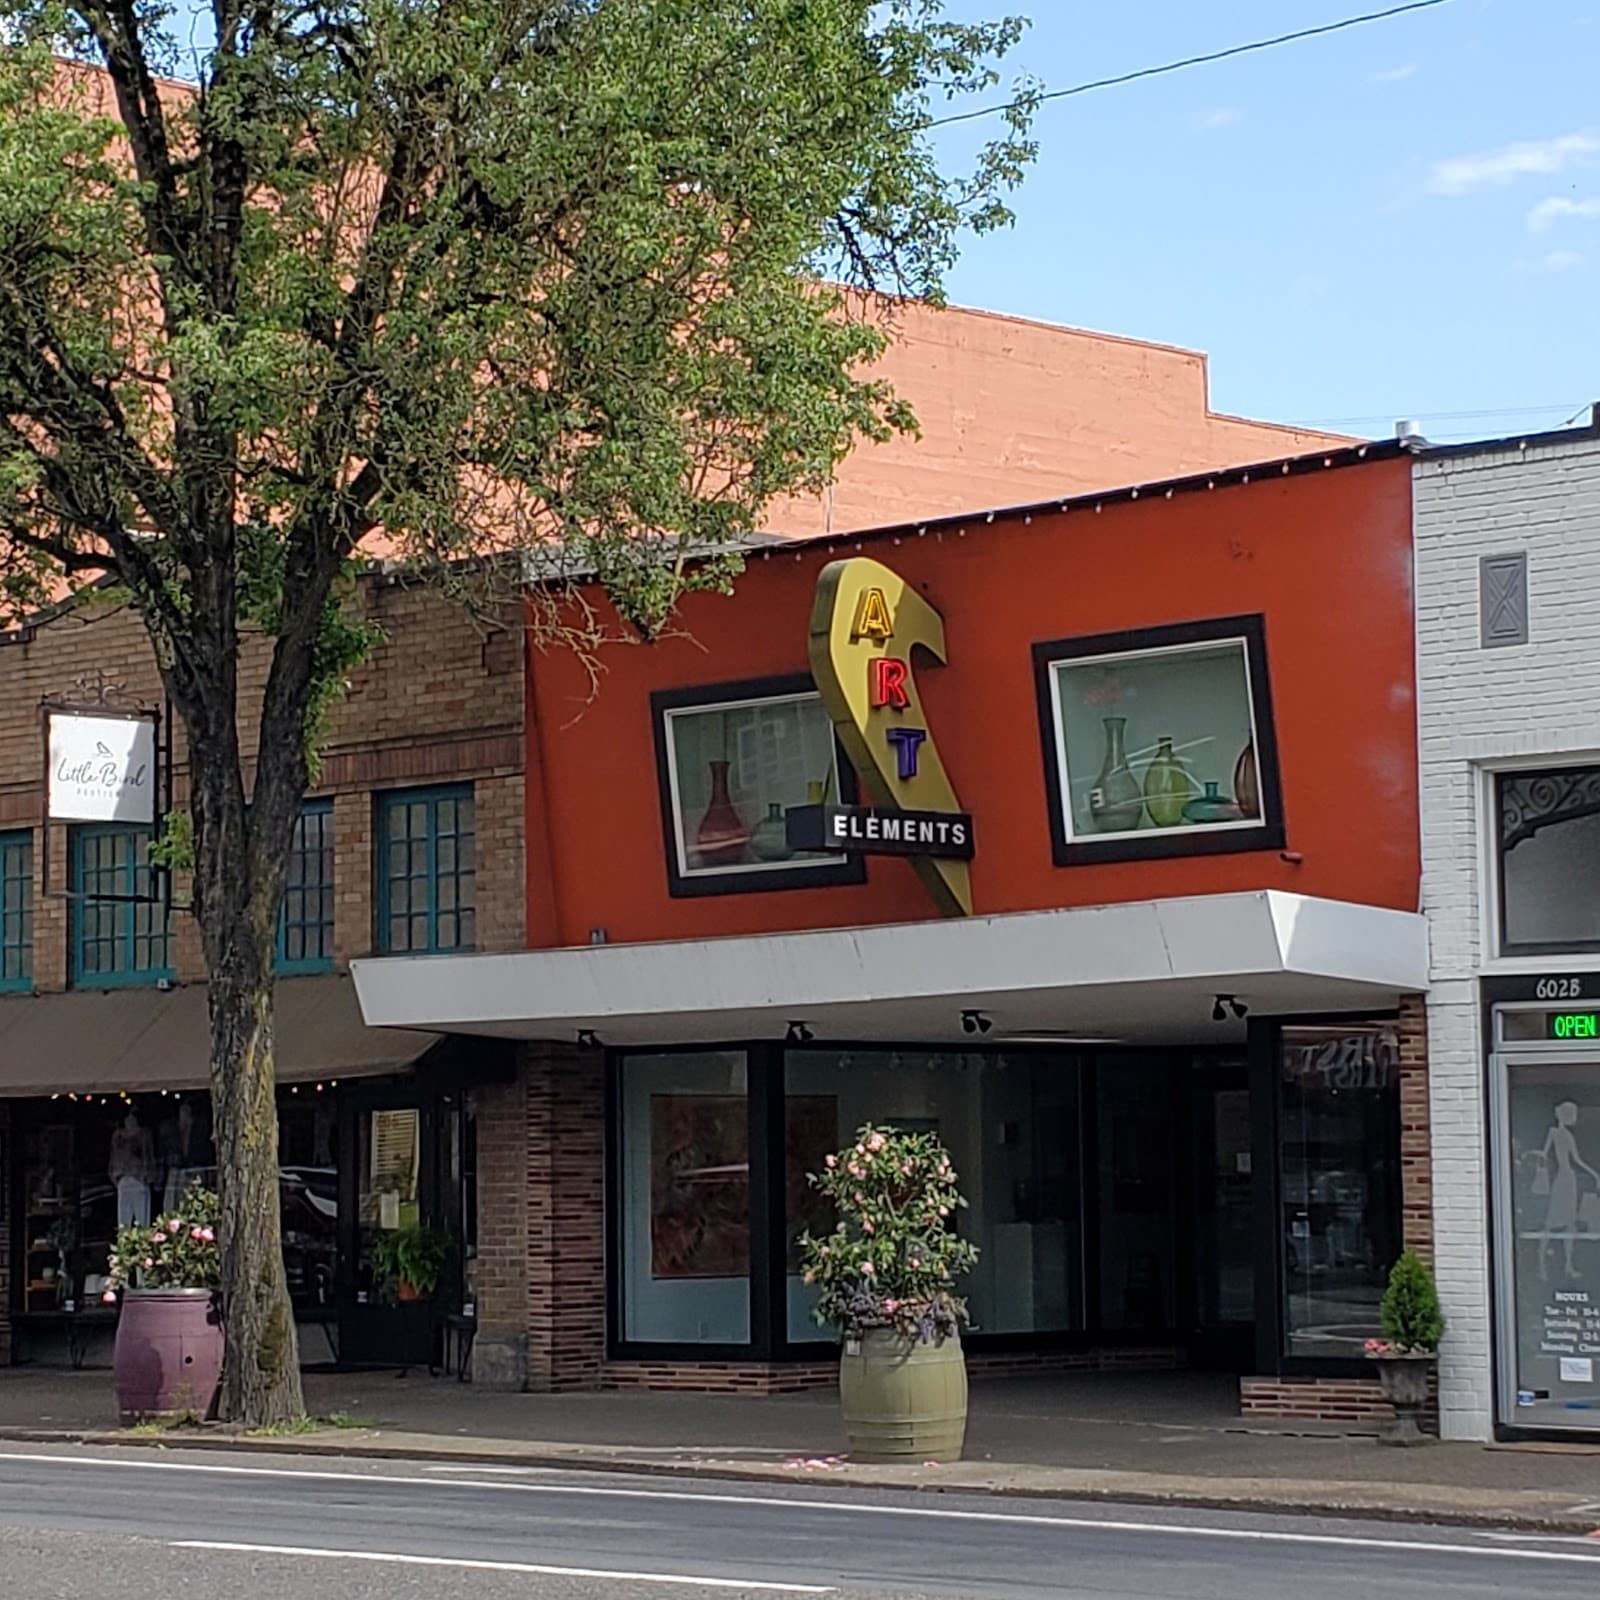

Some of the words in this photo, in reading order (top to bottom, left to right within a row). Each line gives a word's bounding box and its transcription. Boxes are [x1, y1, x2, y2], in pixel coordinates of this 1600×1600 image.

[850, 586, 926, 780] ART
[57, 757, 98, 784] Little
[99, 761, 147, 787] Bird
[833, 815, 967, 845] ELEMENTS
[1536, 978, 1581, 999] 602B
[1554, 1015, 1597, 1037] OPEN
